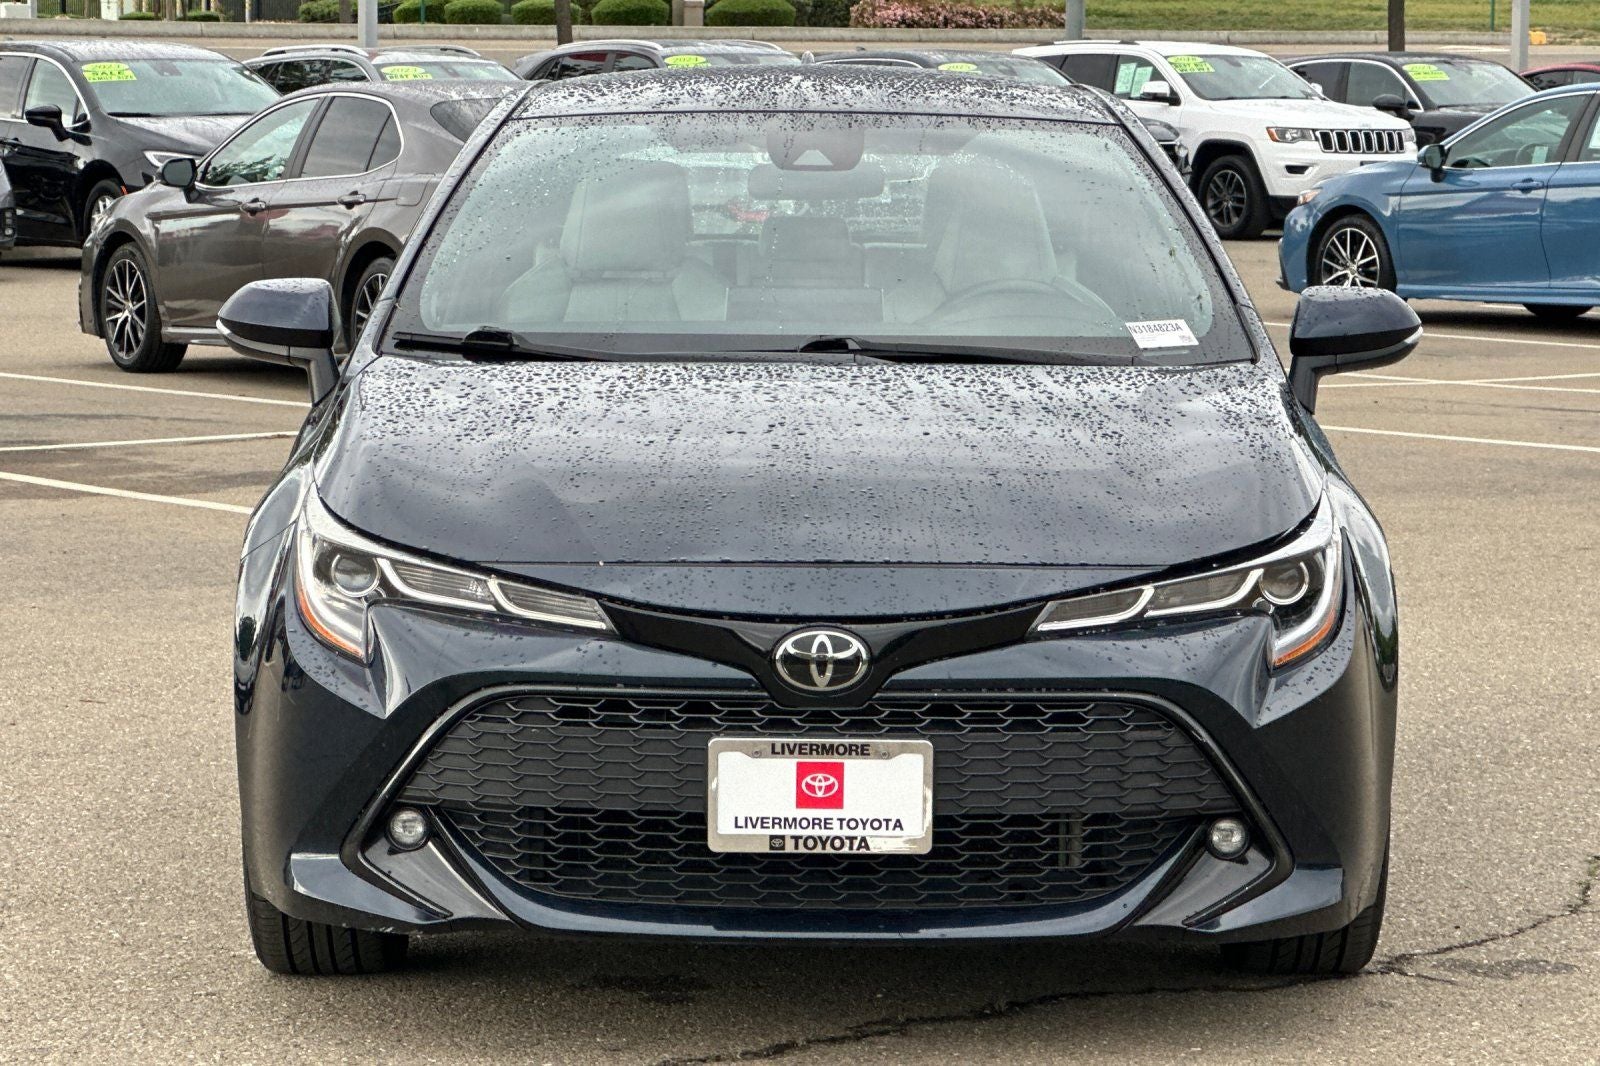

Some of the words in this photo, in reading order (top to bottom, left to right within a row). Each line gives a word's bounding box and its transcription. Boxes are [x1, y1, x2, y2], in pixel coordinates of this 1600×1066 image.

[1128, 322, 1184, 334] N3184823A
[770, 743, 871, 756] LIVERMORE
[734, 816, 834, 830] LIVERMORE
[837, 818, 904, 831] TOYOTA
[790, 835, 871, 851] TOYOTA
